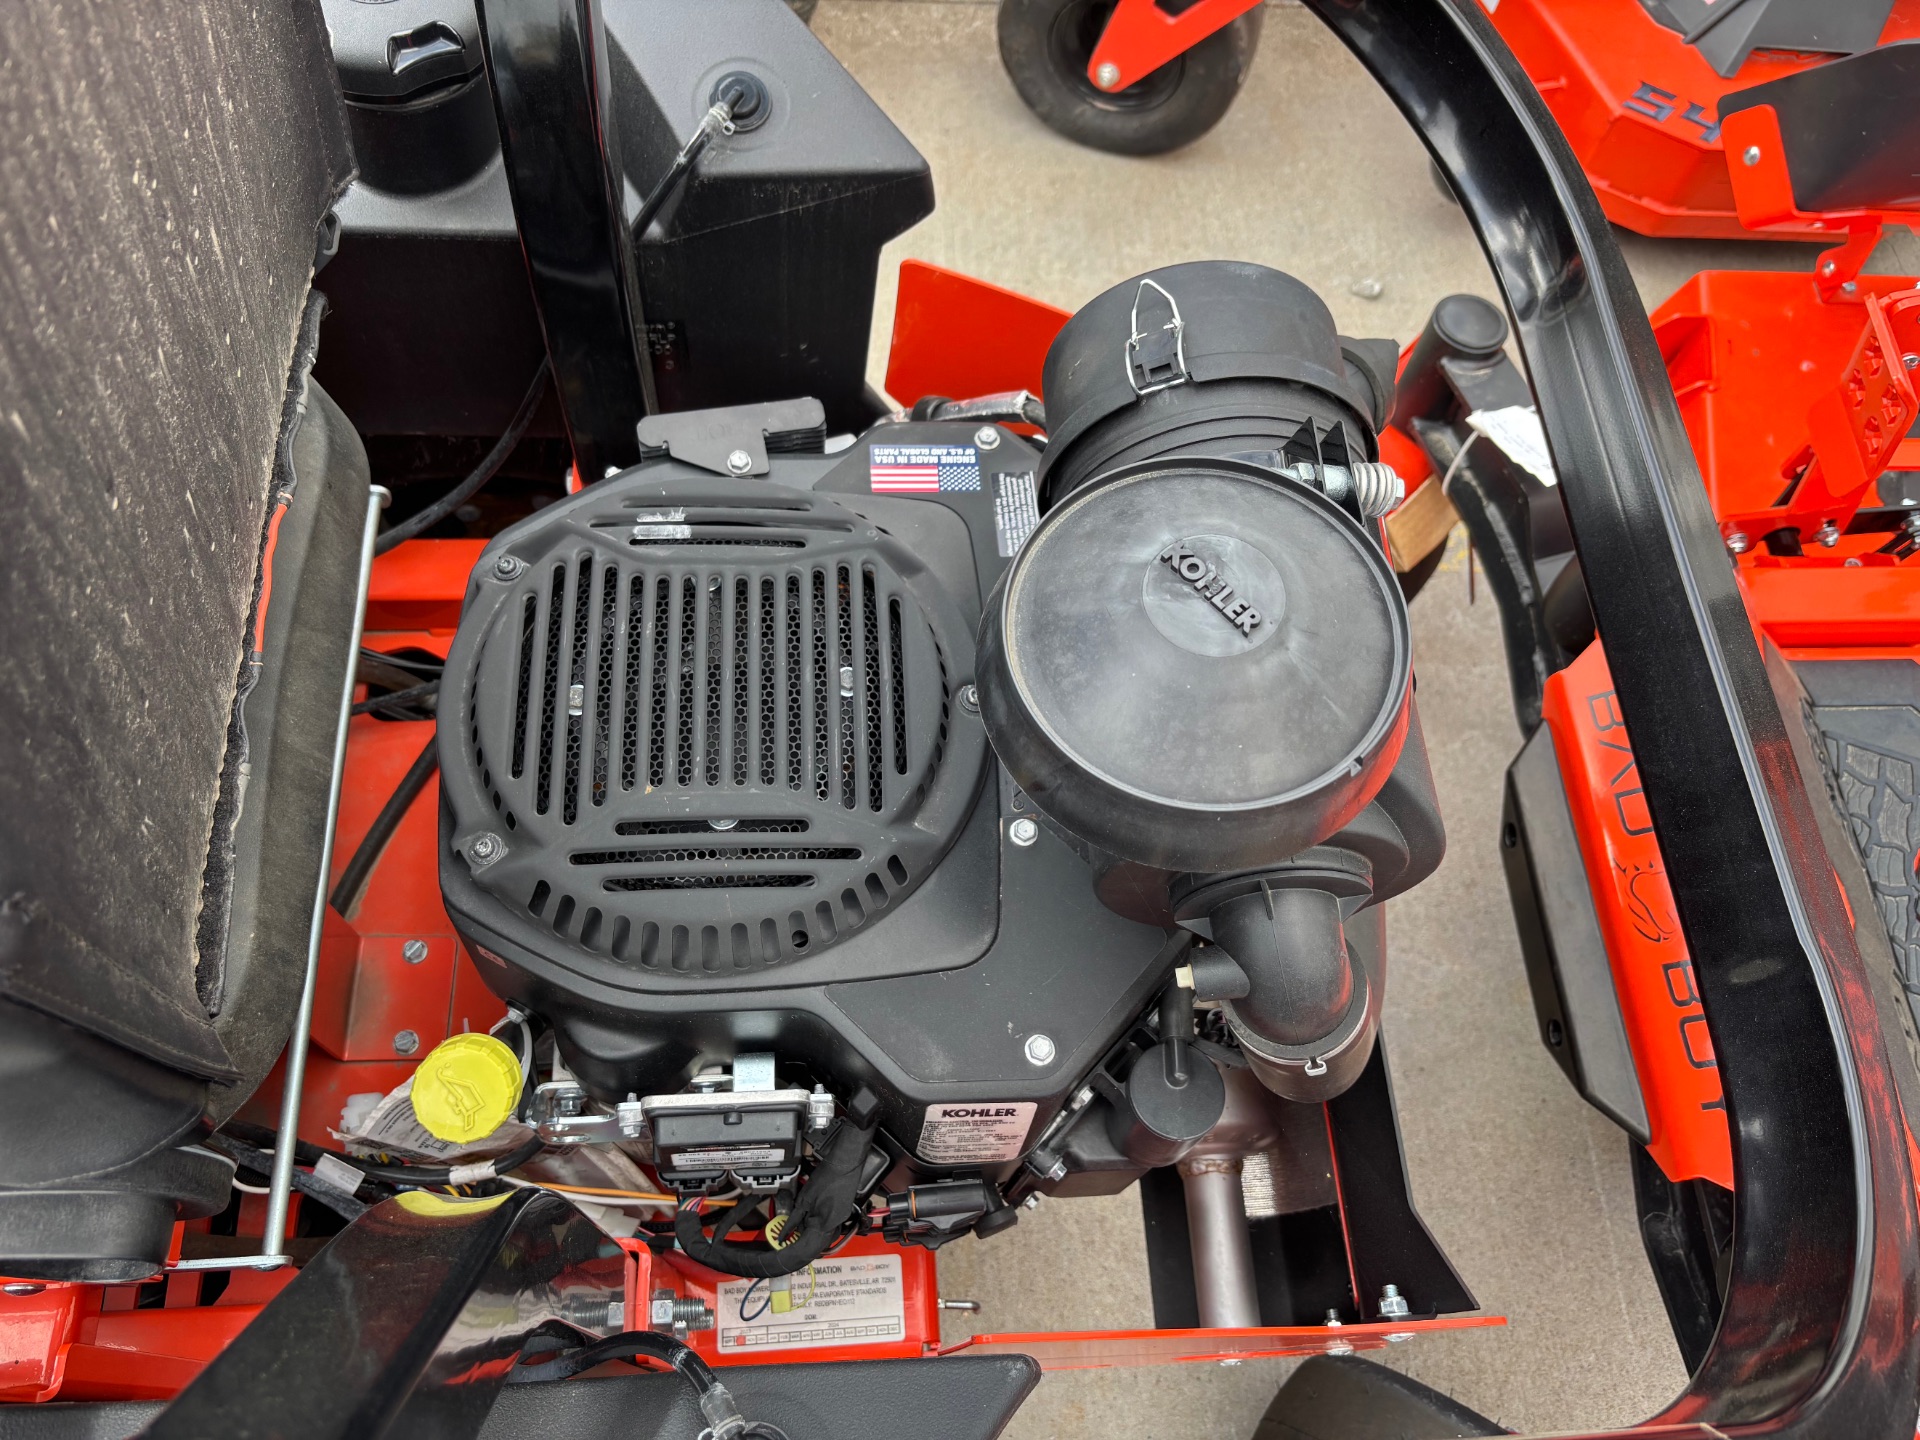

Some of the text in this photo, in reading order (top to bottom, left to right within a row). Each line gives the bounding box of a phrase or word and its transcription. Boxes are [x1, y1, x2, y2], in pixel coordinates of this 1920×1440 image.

[1160, 541, 1262, 638] KOHLER
[941, 1108, 1017, 1118] KOHLER
[797, 1279, 826, 1290] INDUSRIAL
